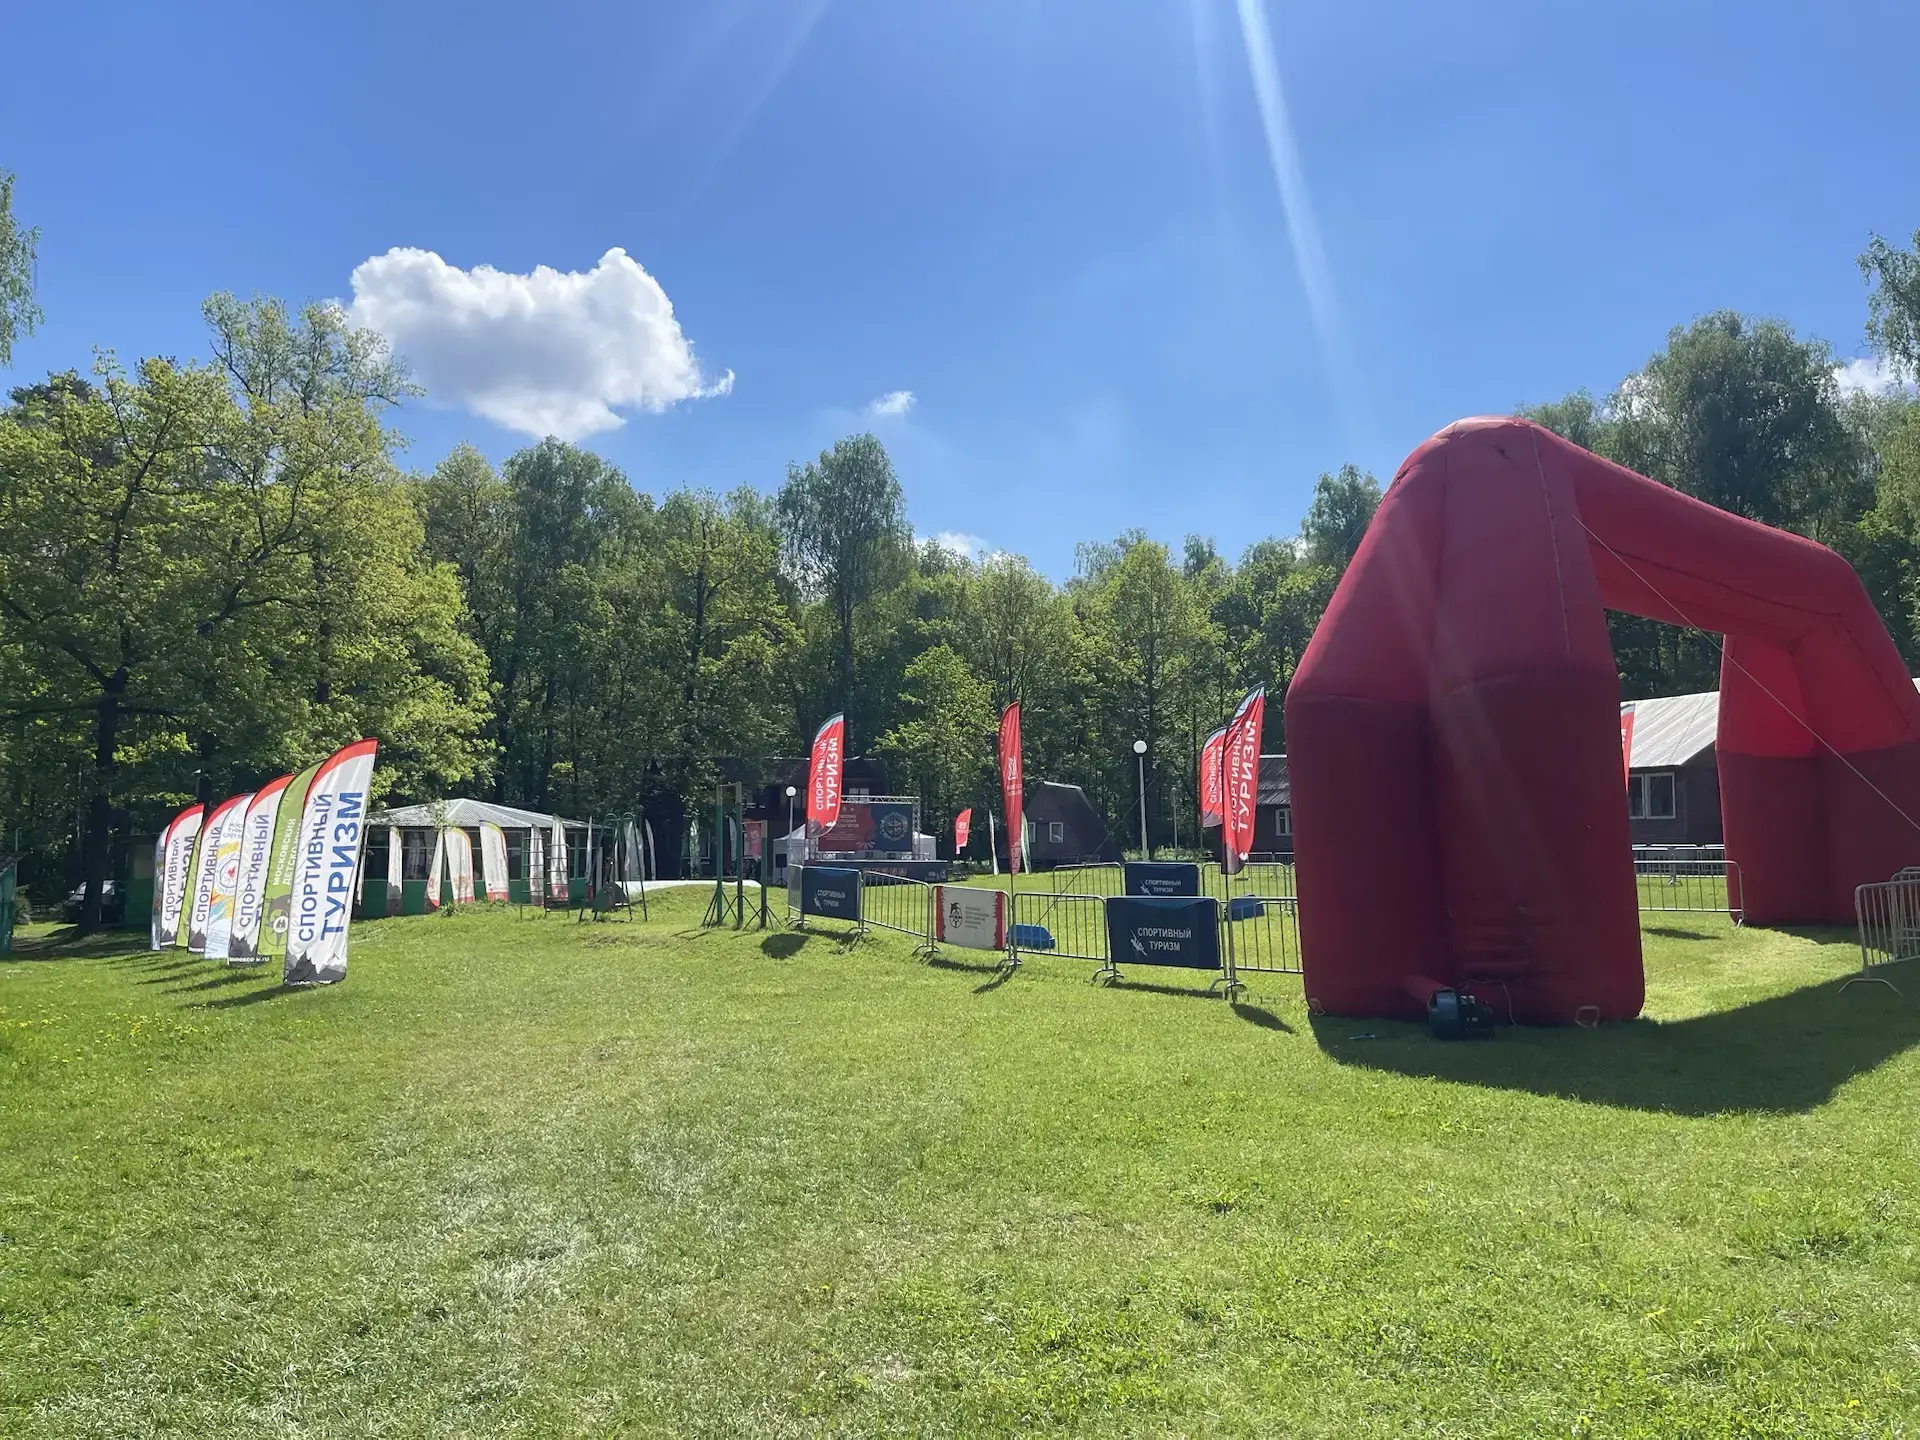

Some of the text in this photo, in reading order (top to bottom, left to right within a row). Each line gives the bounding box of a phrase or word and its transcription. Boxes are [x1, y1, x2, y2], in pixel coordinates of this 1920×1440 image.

[826, 737, 839, 811] ТУРИЗМ
[1238, 720, 1257, 833] ТУРИЗМ
[164, 837, 180, 921] СПОРТИВНЫЙ
[195, 826, 222, 923] СПОРТИВНЫЙ
[239, 814, 271, 928] СПОРТИВНЫЙ
[298, 794, 333, 943] СПОРТИВНЫЙ
[320, 792, 363, 941] ТУРИЗМ
[1137, 927, 1192, 939] СПОРТИВНЫЙ
[1149, 940, 1181, 951] ТУРИЗМ
